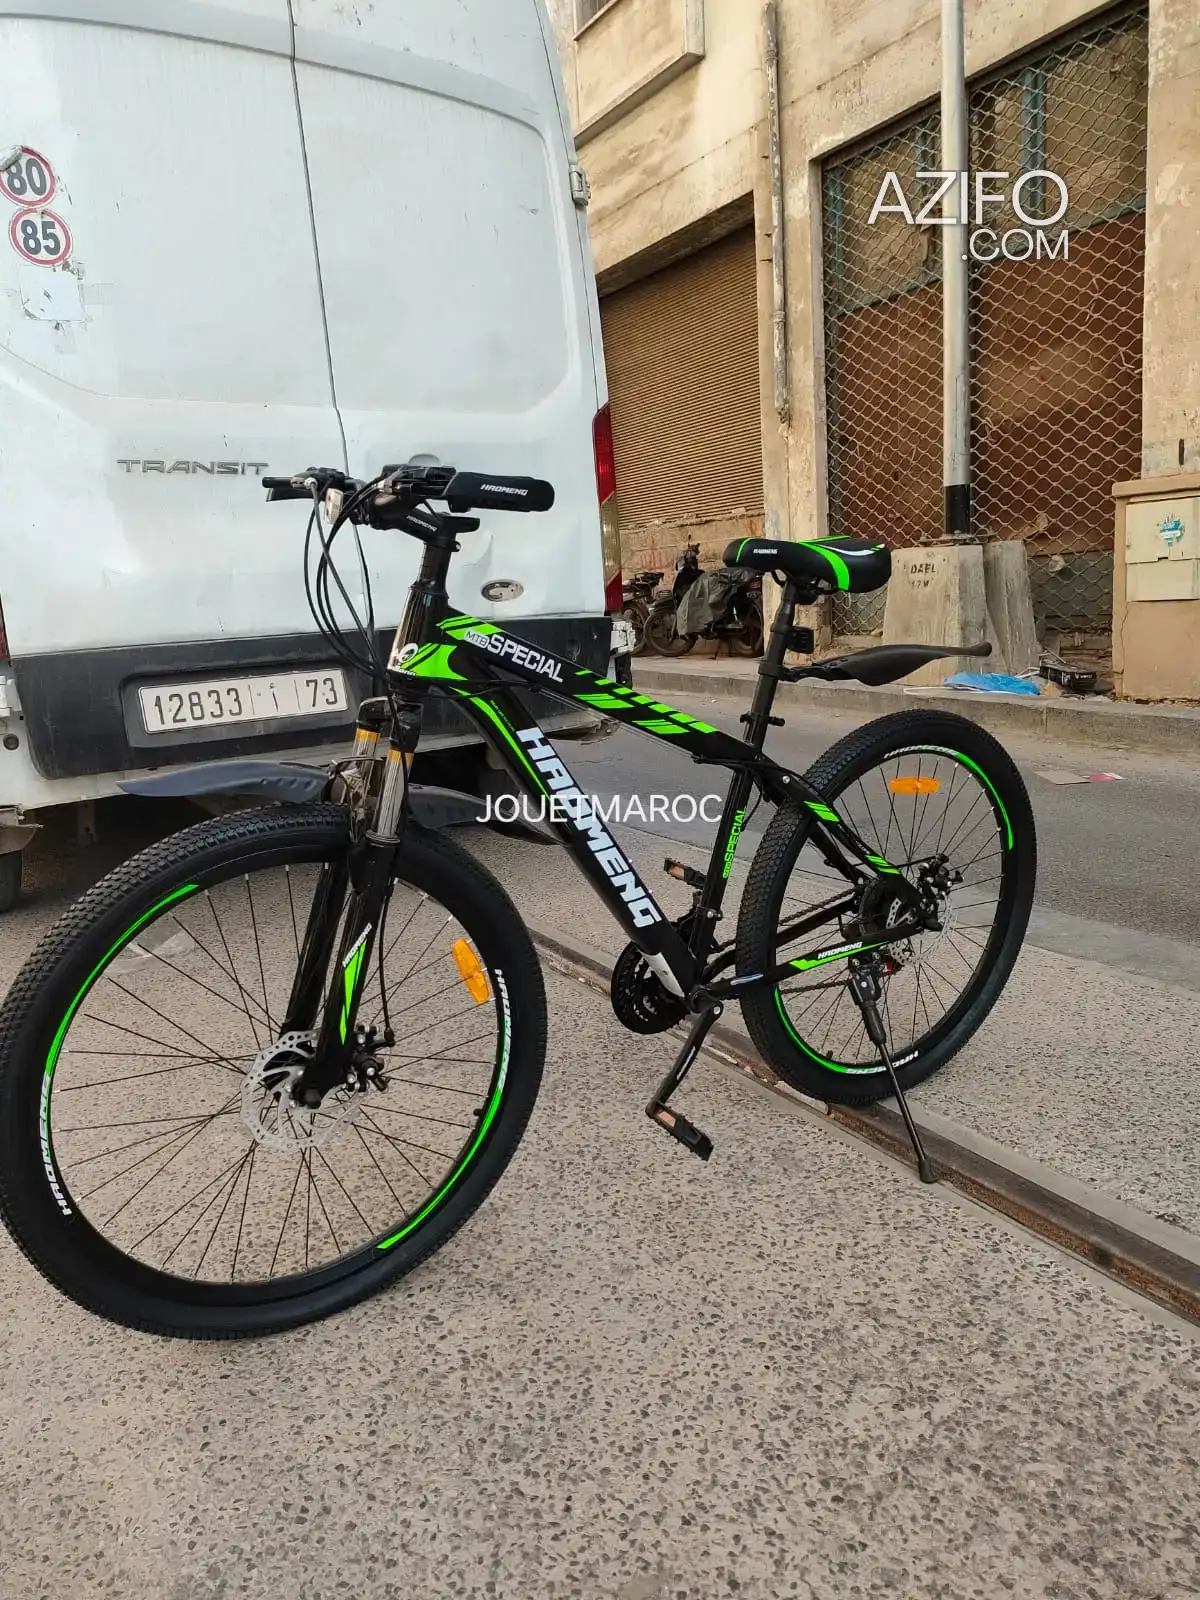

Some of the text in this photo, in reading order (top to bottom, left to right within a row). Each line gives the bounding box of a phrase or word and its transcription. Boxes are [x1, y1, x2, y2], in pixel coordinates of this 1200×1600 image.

[6, 158, 47, 197] 80
[20, 219, 61, 256] 85
[116, 459, 269, 476] TRANSIT
[480, 483, 529, 497] HAOMENG
[487, 633, 564, 683] SPECIAL
[153, 687, 243, 726] 12833
[305, 677, 338, 708] 73
[724, 806, 747, 861] SPECIAL
